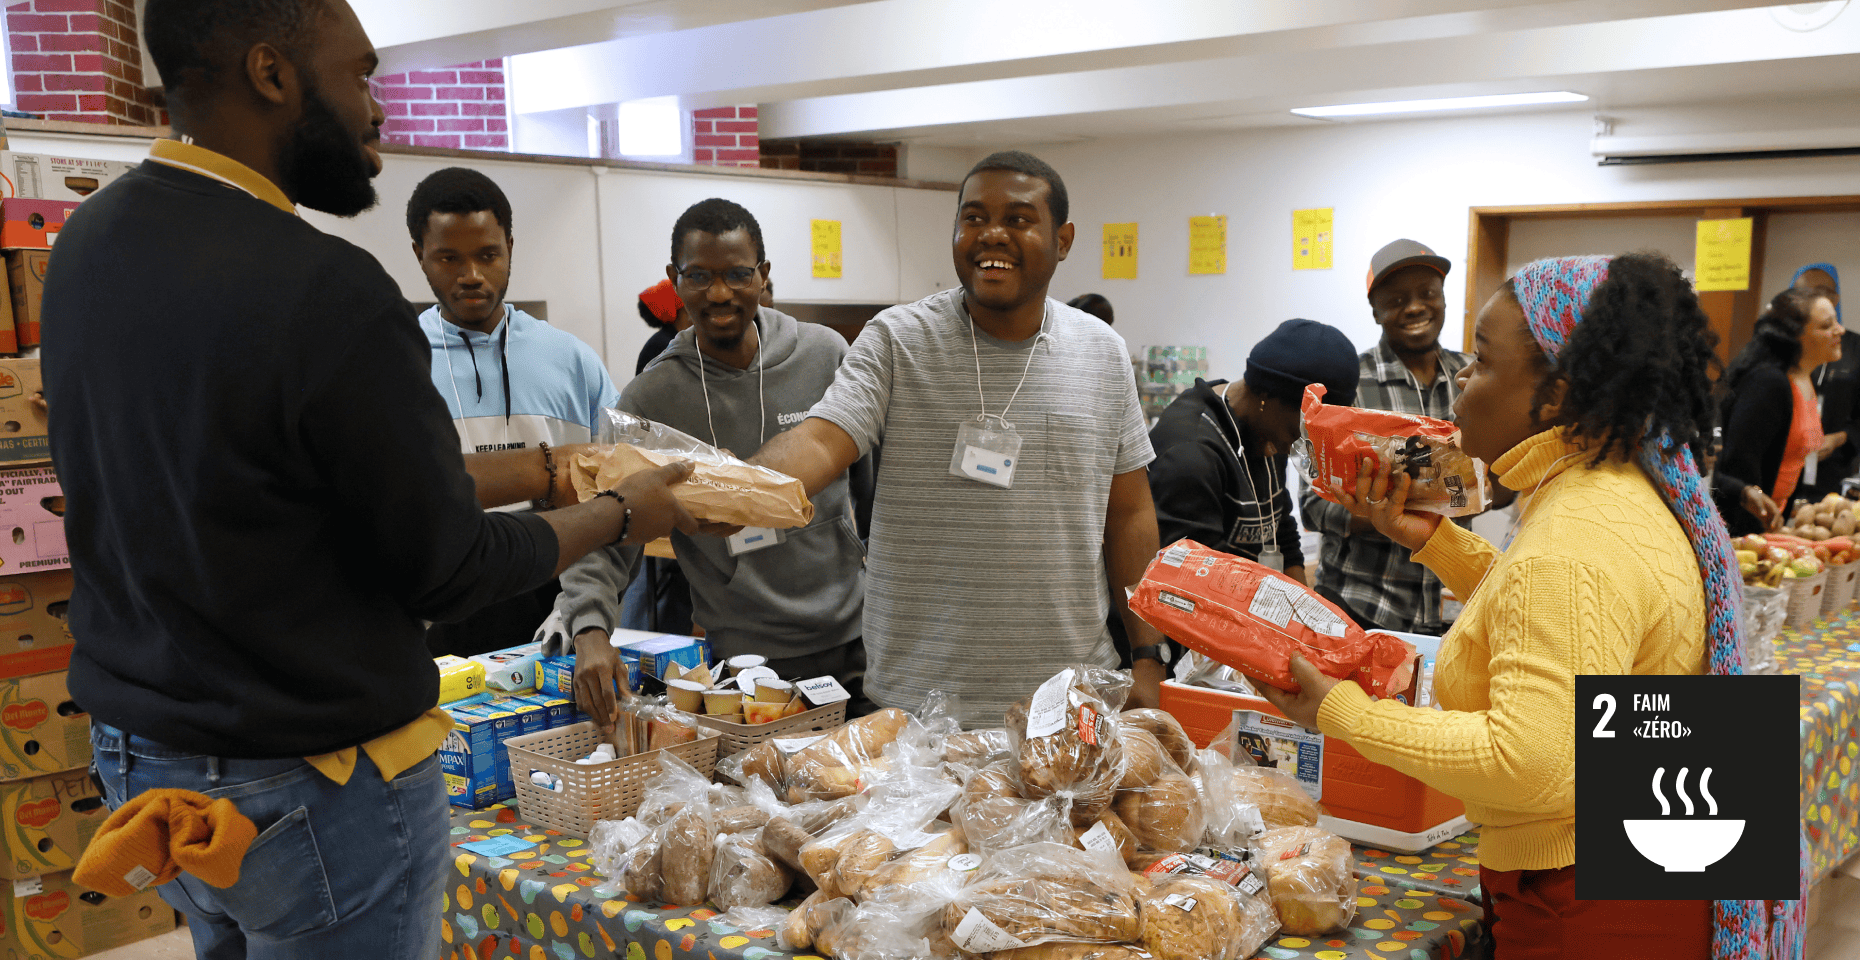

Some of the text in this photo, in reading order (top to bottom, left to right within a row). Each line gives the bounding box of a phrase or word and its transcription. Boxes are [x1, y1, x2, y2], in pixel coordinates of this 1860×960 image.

[50, 157, 67, 165] STORE
[475, 444, 493, 453] KEEP
[5, 487, 24, 496] OUT
[19, 558, 61, 569] PREMIUM
[804, 681, 833, 691] belsoy
[440, 753, 464, 766] MPAX
